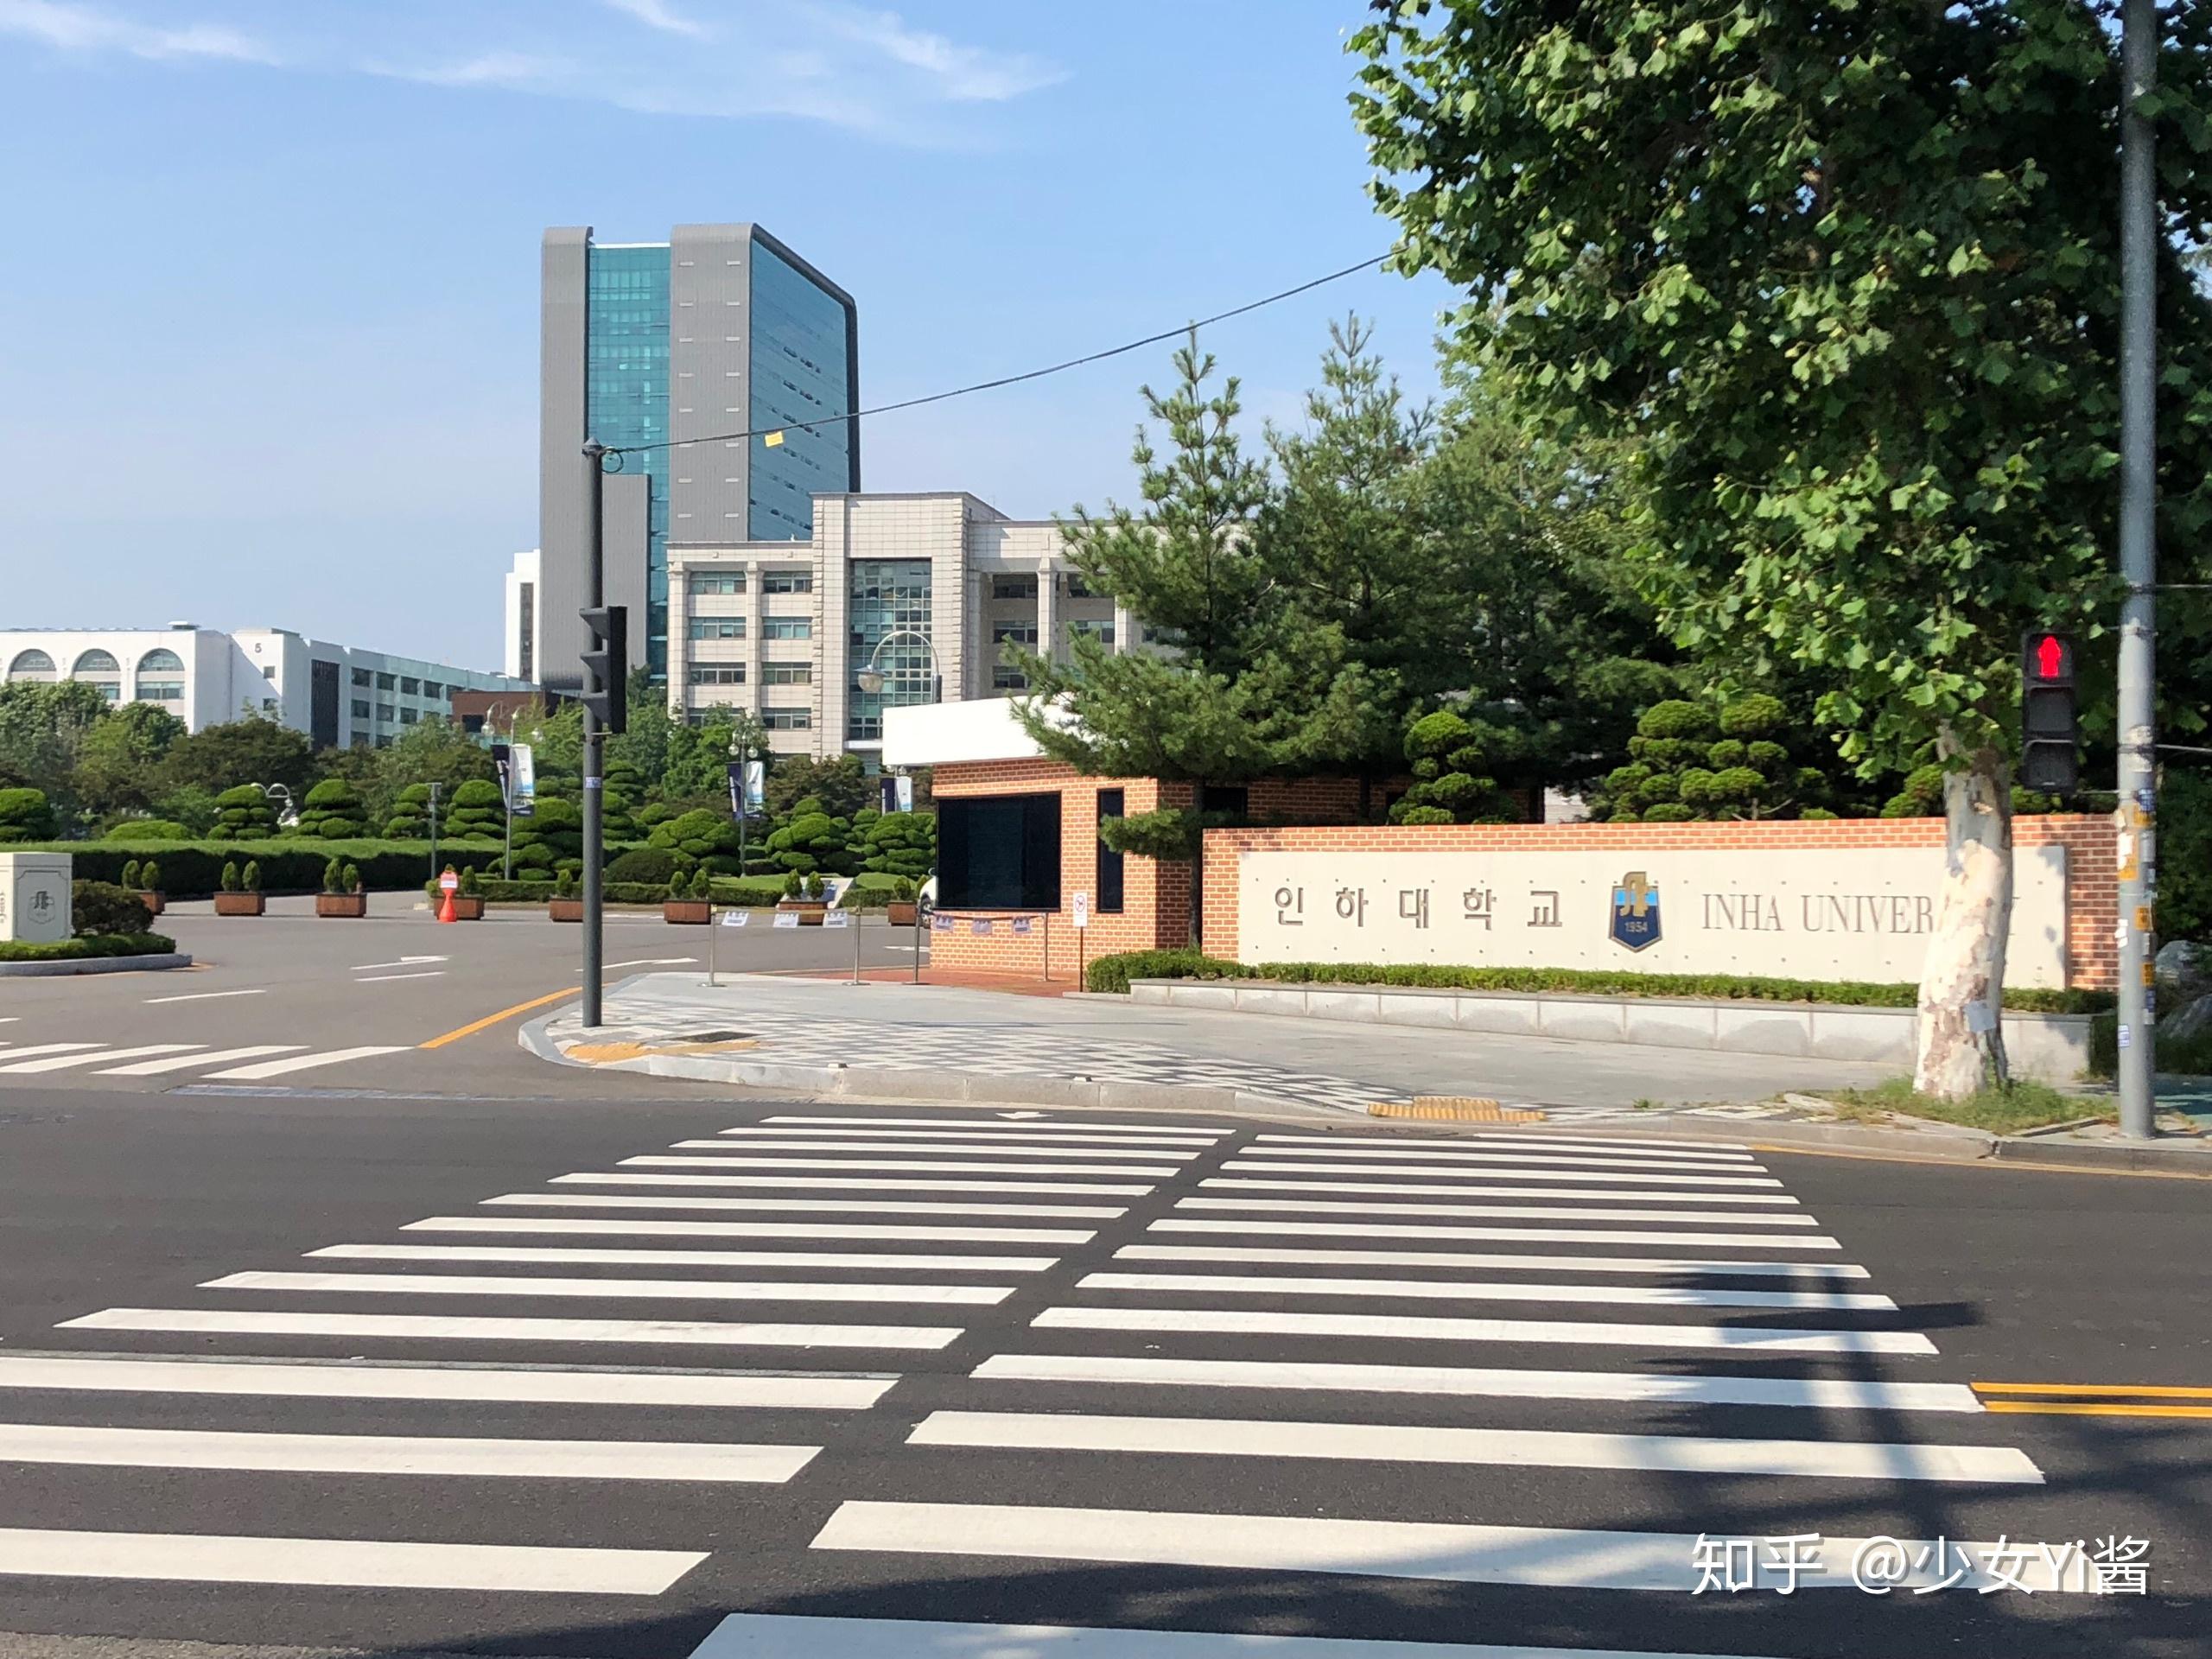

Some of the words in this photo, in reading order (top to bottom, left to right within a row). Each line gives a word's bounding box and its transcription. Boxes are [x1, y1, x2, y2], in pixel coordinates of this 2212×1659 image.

[1274, 887, 1563, 931] 인하대학교
[1701, 893, 1784, 931] INHA
[1802, 894, 2020, 933] UNIVER
